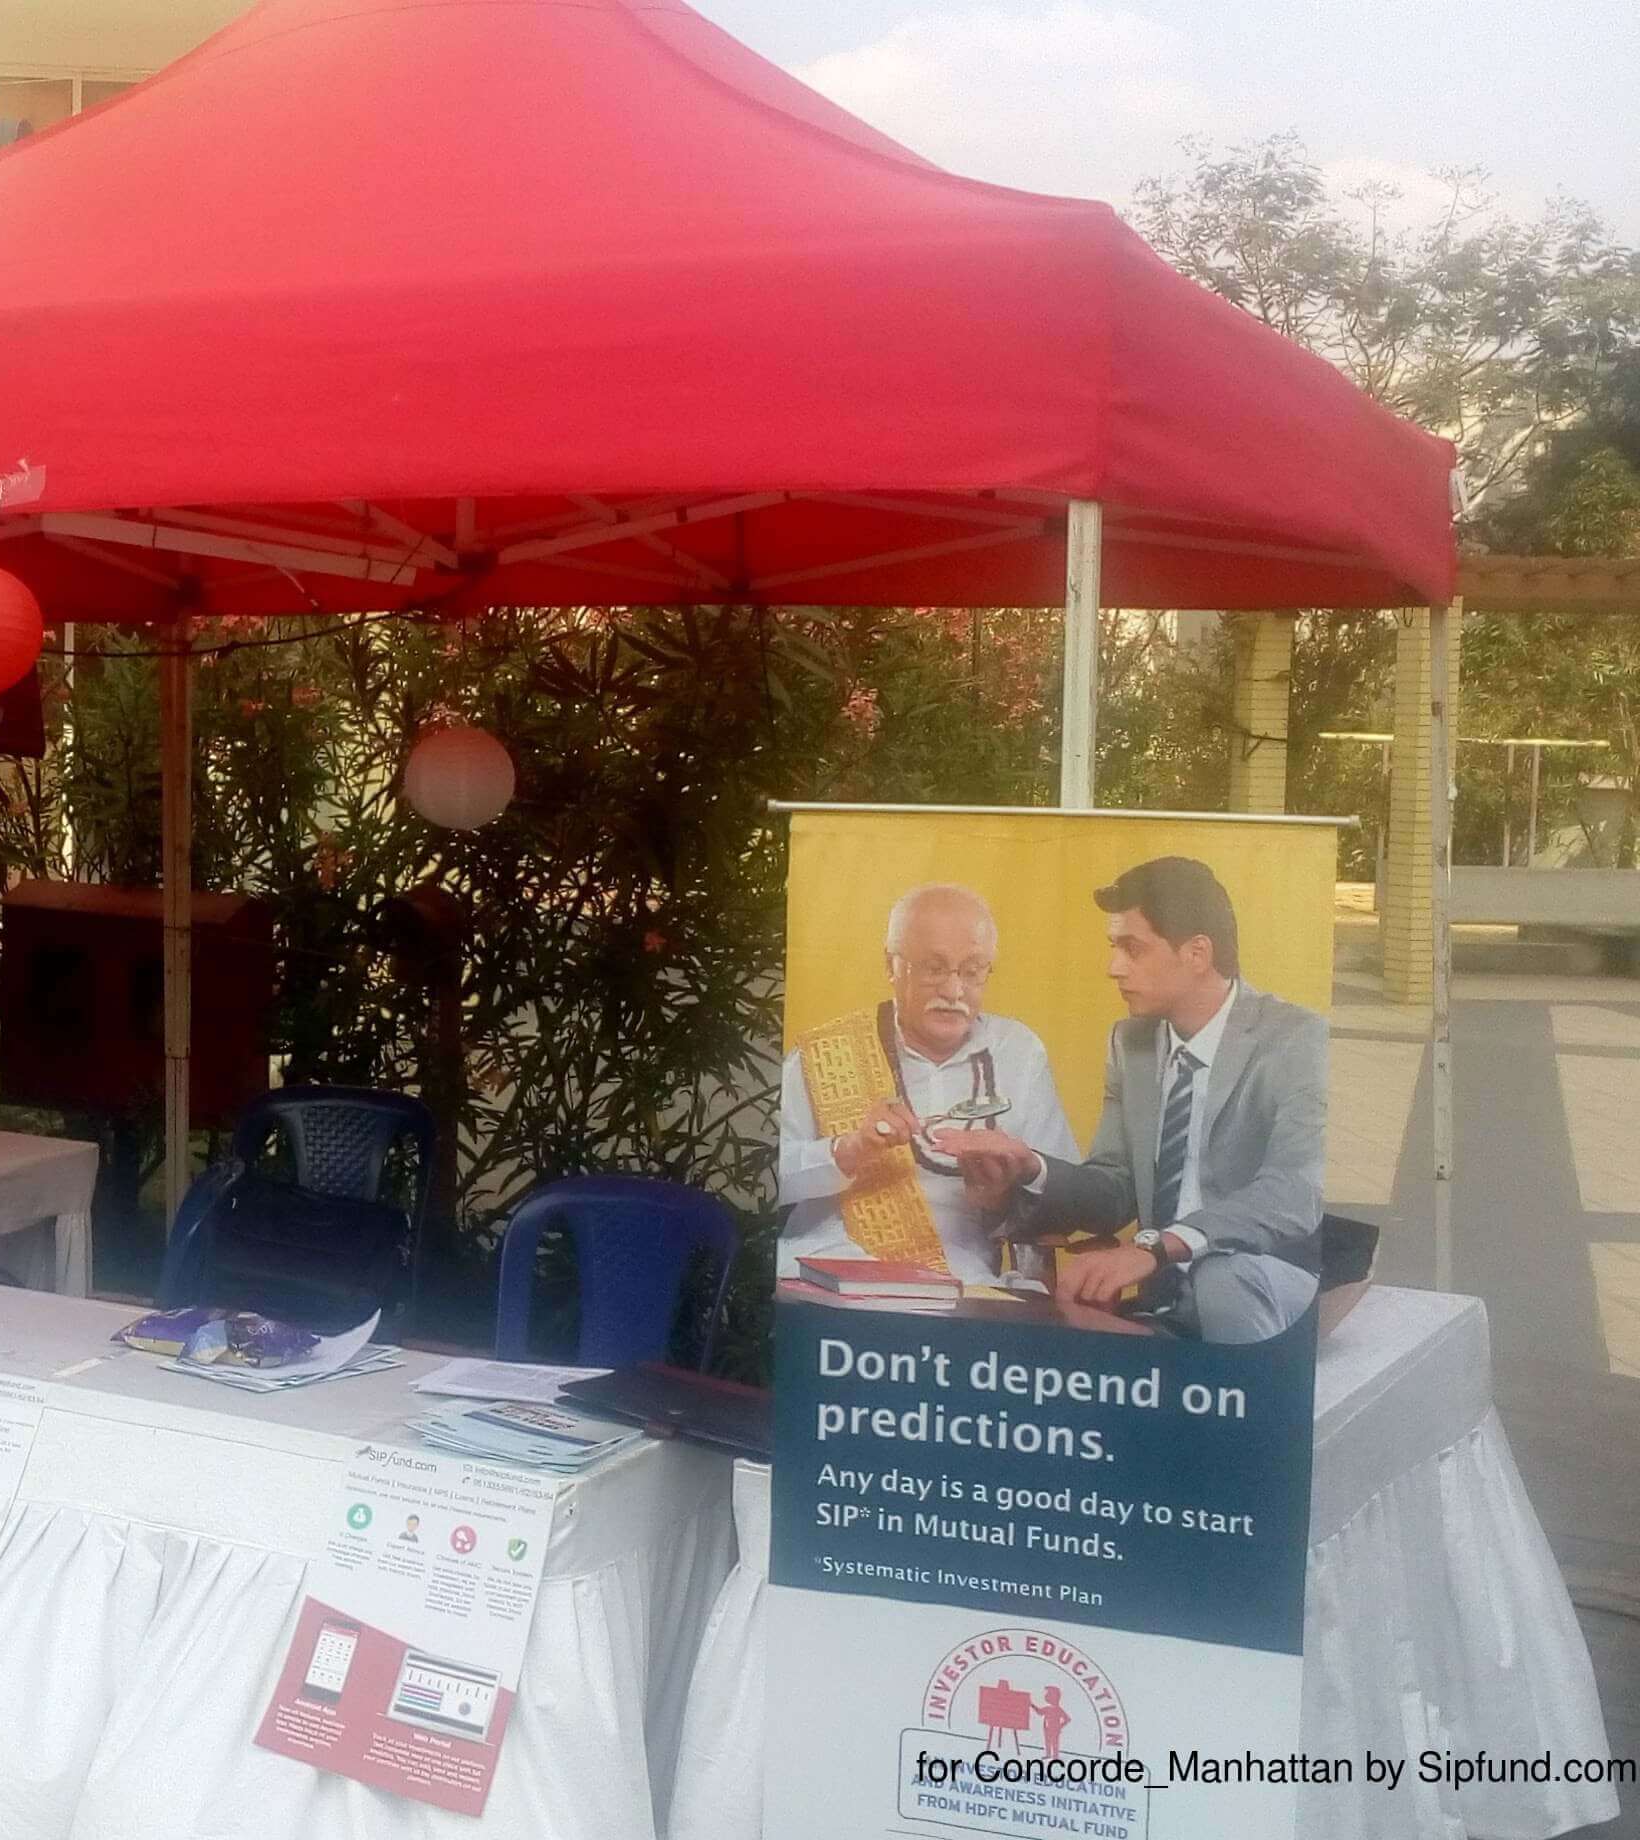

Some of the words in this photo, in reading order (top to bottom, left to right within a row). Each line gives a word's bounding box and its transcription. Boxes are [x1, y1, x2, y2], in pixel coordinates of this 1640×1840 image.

[968, 1350, 1161, 1410] depend
[1181, 1382, 1247, 1419] on
[816, 1400, 1116, 1464] predictions.
[816, 1462, 875, 1497] Any
[880, 1466, 933, 1501] day
[940, 1471, 964, 1500] is
[972, 1482, 989, 1504] a
[996, 1481, 1072, 1515] good
[1079, 1490, 1135, 1527] day
[1142, 1500, 1174, 1527] to
[1181, 1505, 1255, 1538] start
[877, 1506, 904, 1534] in
[913, 1510, 1016, 1549] Mutual
[1025, 1523, 1125, 1562] Funds.
[936, 1567, 1053, 1600] Investment
[1058, 1582, 1104, 1608] Plan
[927, 1635, 1014, 1721] INVESTOR
[1024, 1635, 1125, 1749] EDUCATION
[911, 1772, 945, 1790] AND
[948, 1777, 1048, 1808] AWARENESS
[1051, 1795, 1137, 1823] INITIATIVE
[916, 1793, 963, 1815] FROM
[965, 1799, 1008, 1822] HDFC
[1011, 1807, 1080, 1834] MUTUAL
[1083, 1820, 1129, 1840] FUND
